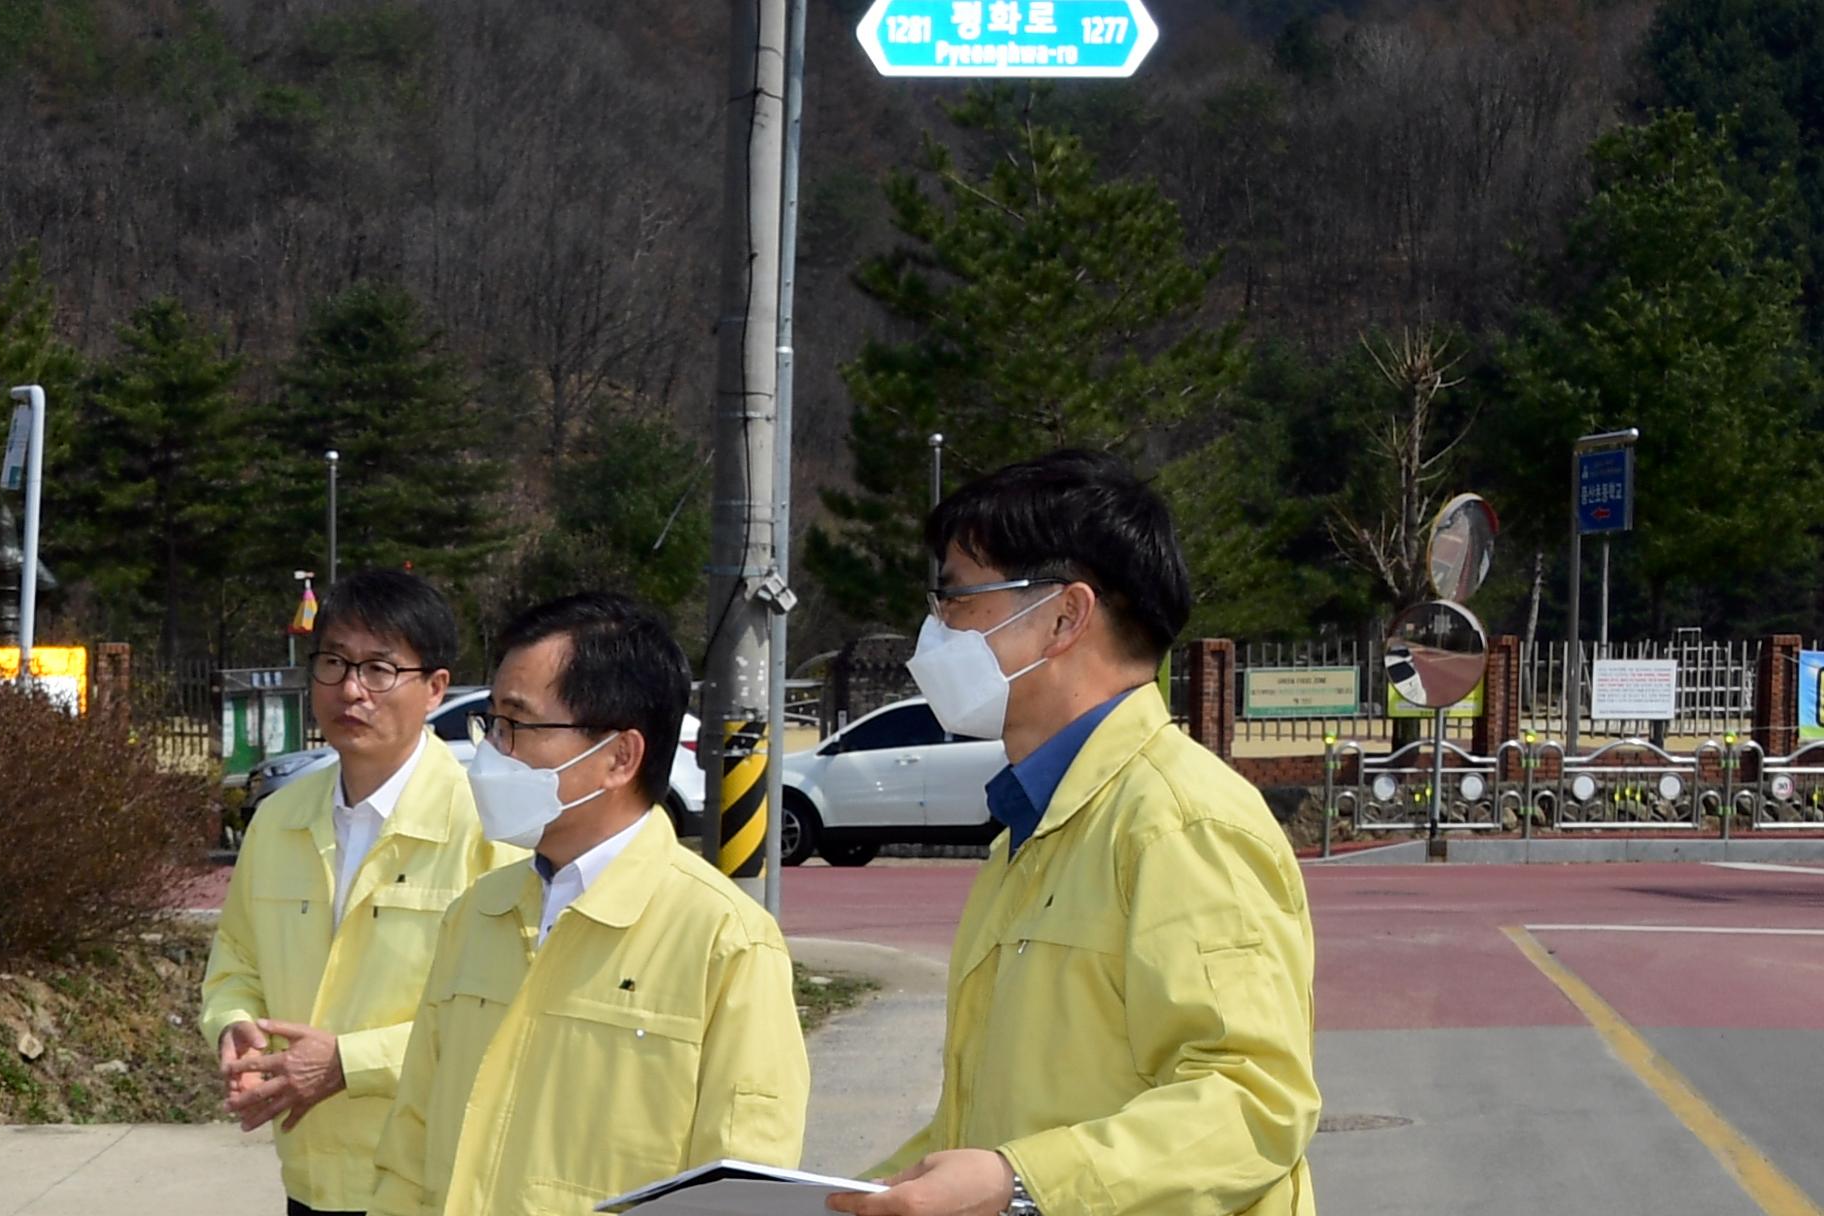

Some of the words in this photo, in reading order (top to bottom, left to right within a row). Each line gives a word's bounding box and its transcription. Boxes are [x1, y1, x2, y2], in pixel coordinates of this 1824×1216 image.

[886, 15, 932, 44] 1281
[951, 0, 1057, 40] 평화로
[1081, 16, 1128, 44] 1277
[935, 40, 1078, 67] Pyeonghwa-ro
